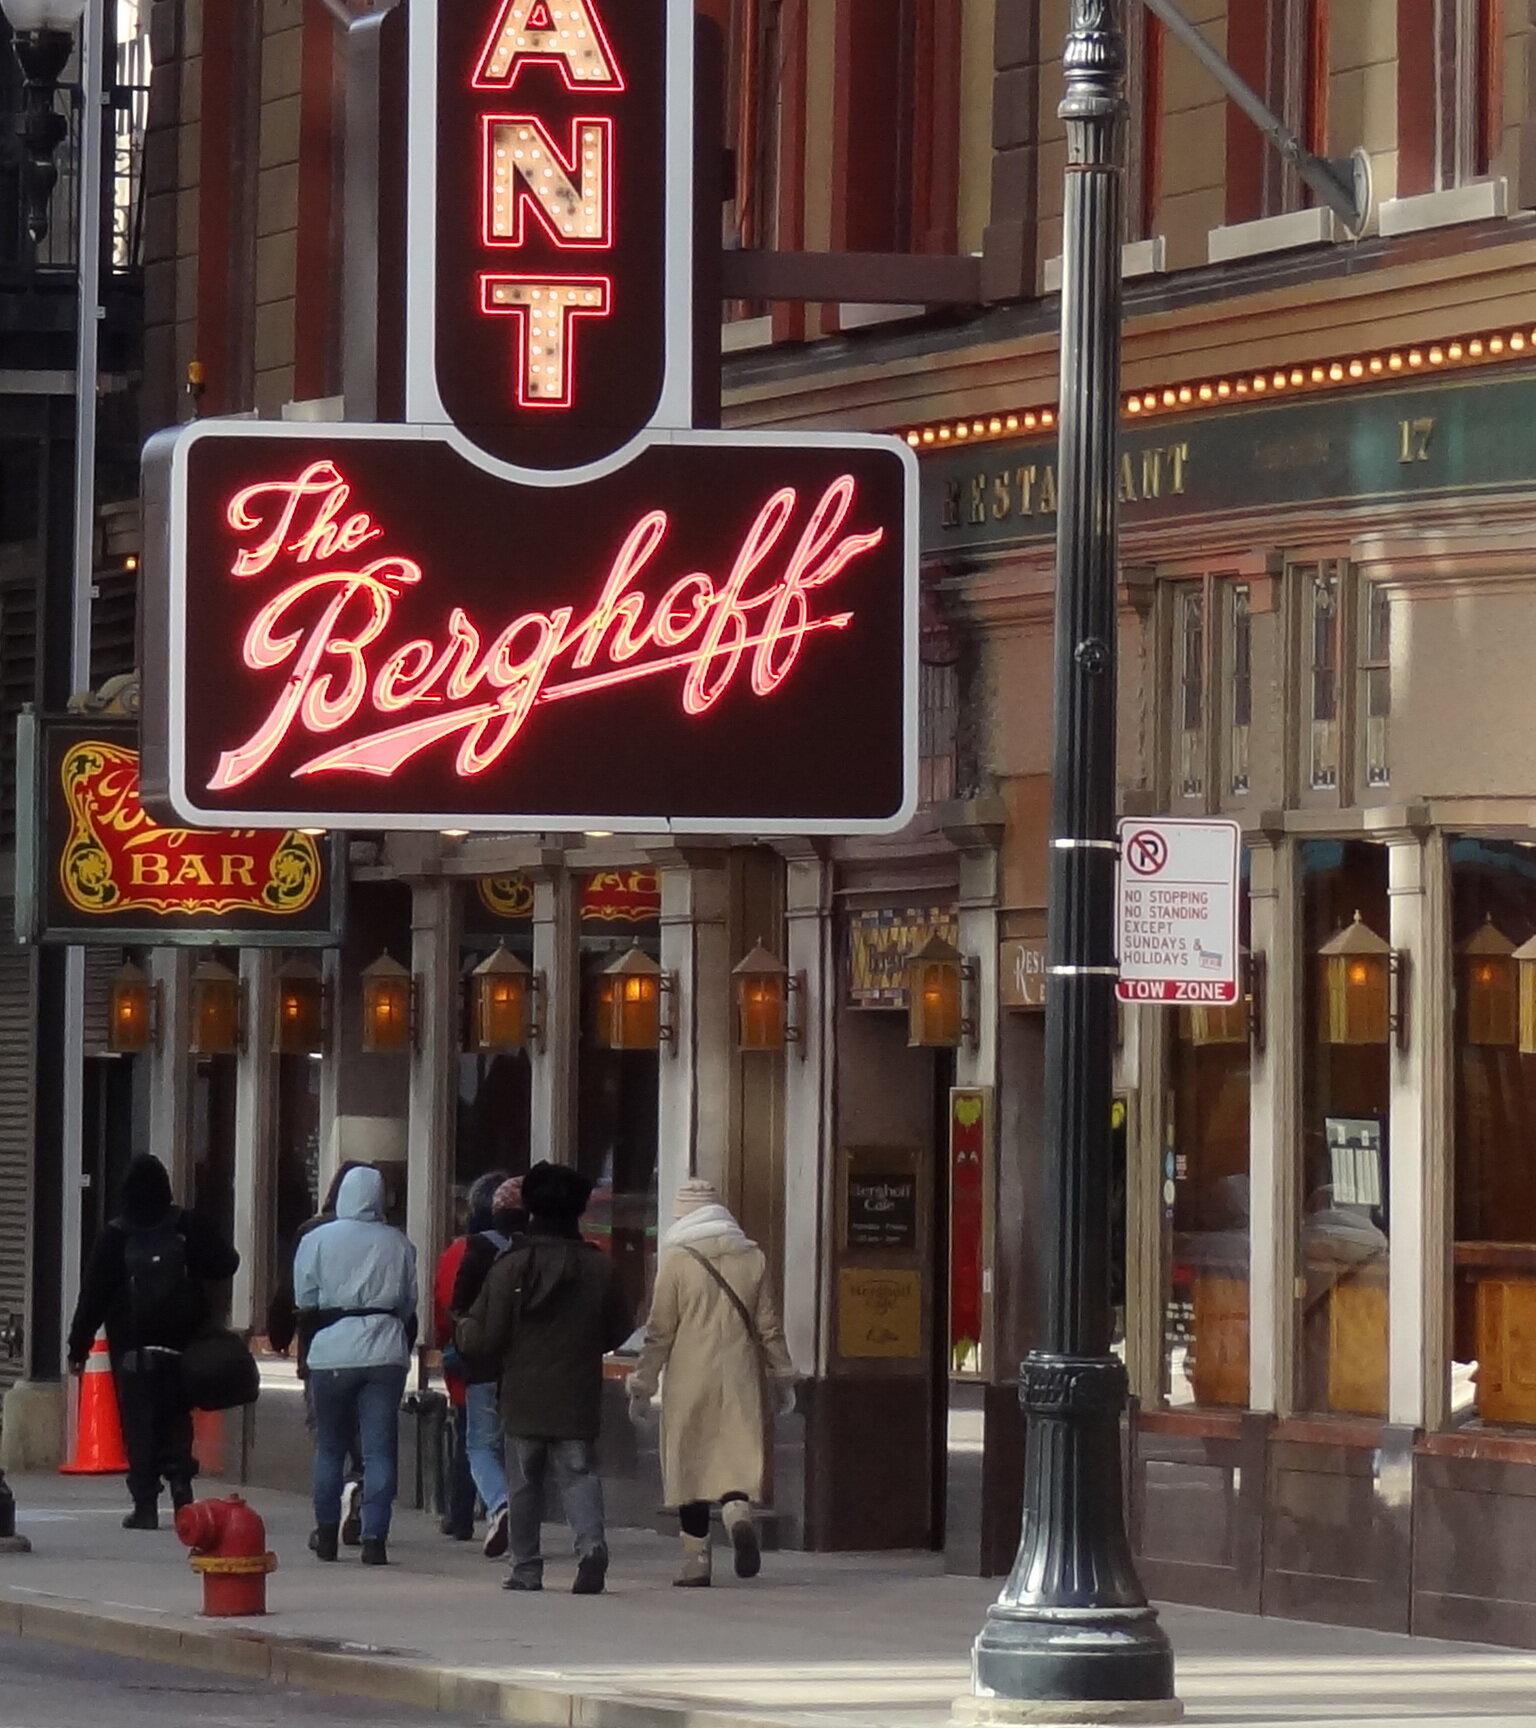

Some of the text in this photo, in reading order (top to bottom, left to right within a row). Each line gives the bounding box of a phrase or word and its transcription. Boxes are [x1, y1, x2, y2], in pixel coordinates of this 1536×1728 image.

[1397, 417, 1436, 464] 17
[941, 442, 1189, 527] RESTAANT
[228, 460, 383, 576] The
[207, 474, 883, 790] Berghoff
[129, 852, 257, 886] BAR
[1124, 889, 1208, 904] NO STOPPING
[1124, 905, 1208, 920] NO STANDING
[1124, 921, 1174, 934] EXCEPT
[1124, 936, 1186, 950] SUNDAYS
[1123, 951, 1189, 965] HOLIDAYS
[1124, 981, 1227, 1000] TOW ZONE
